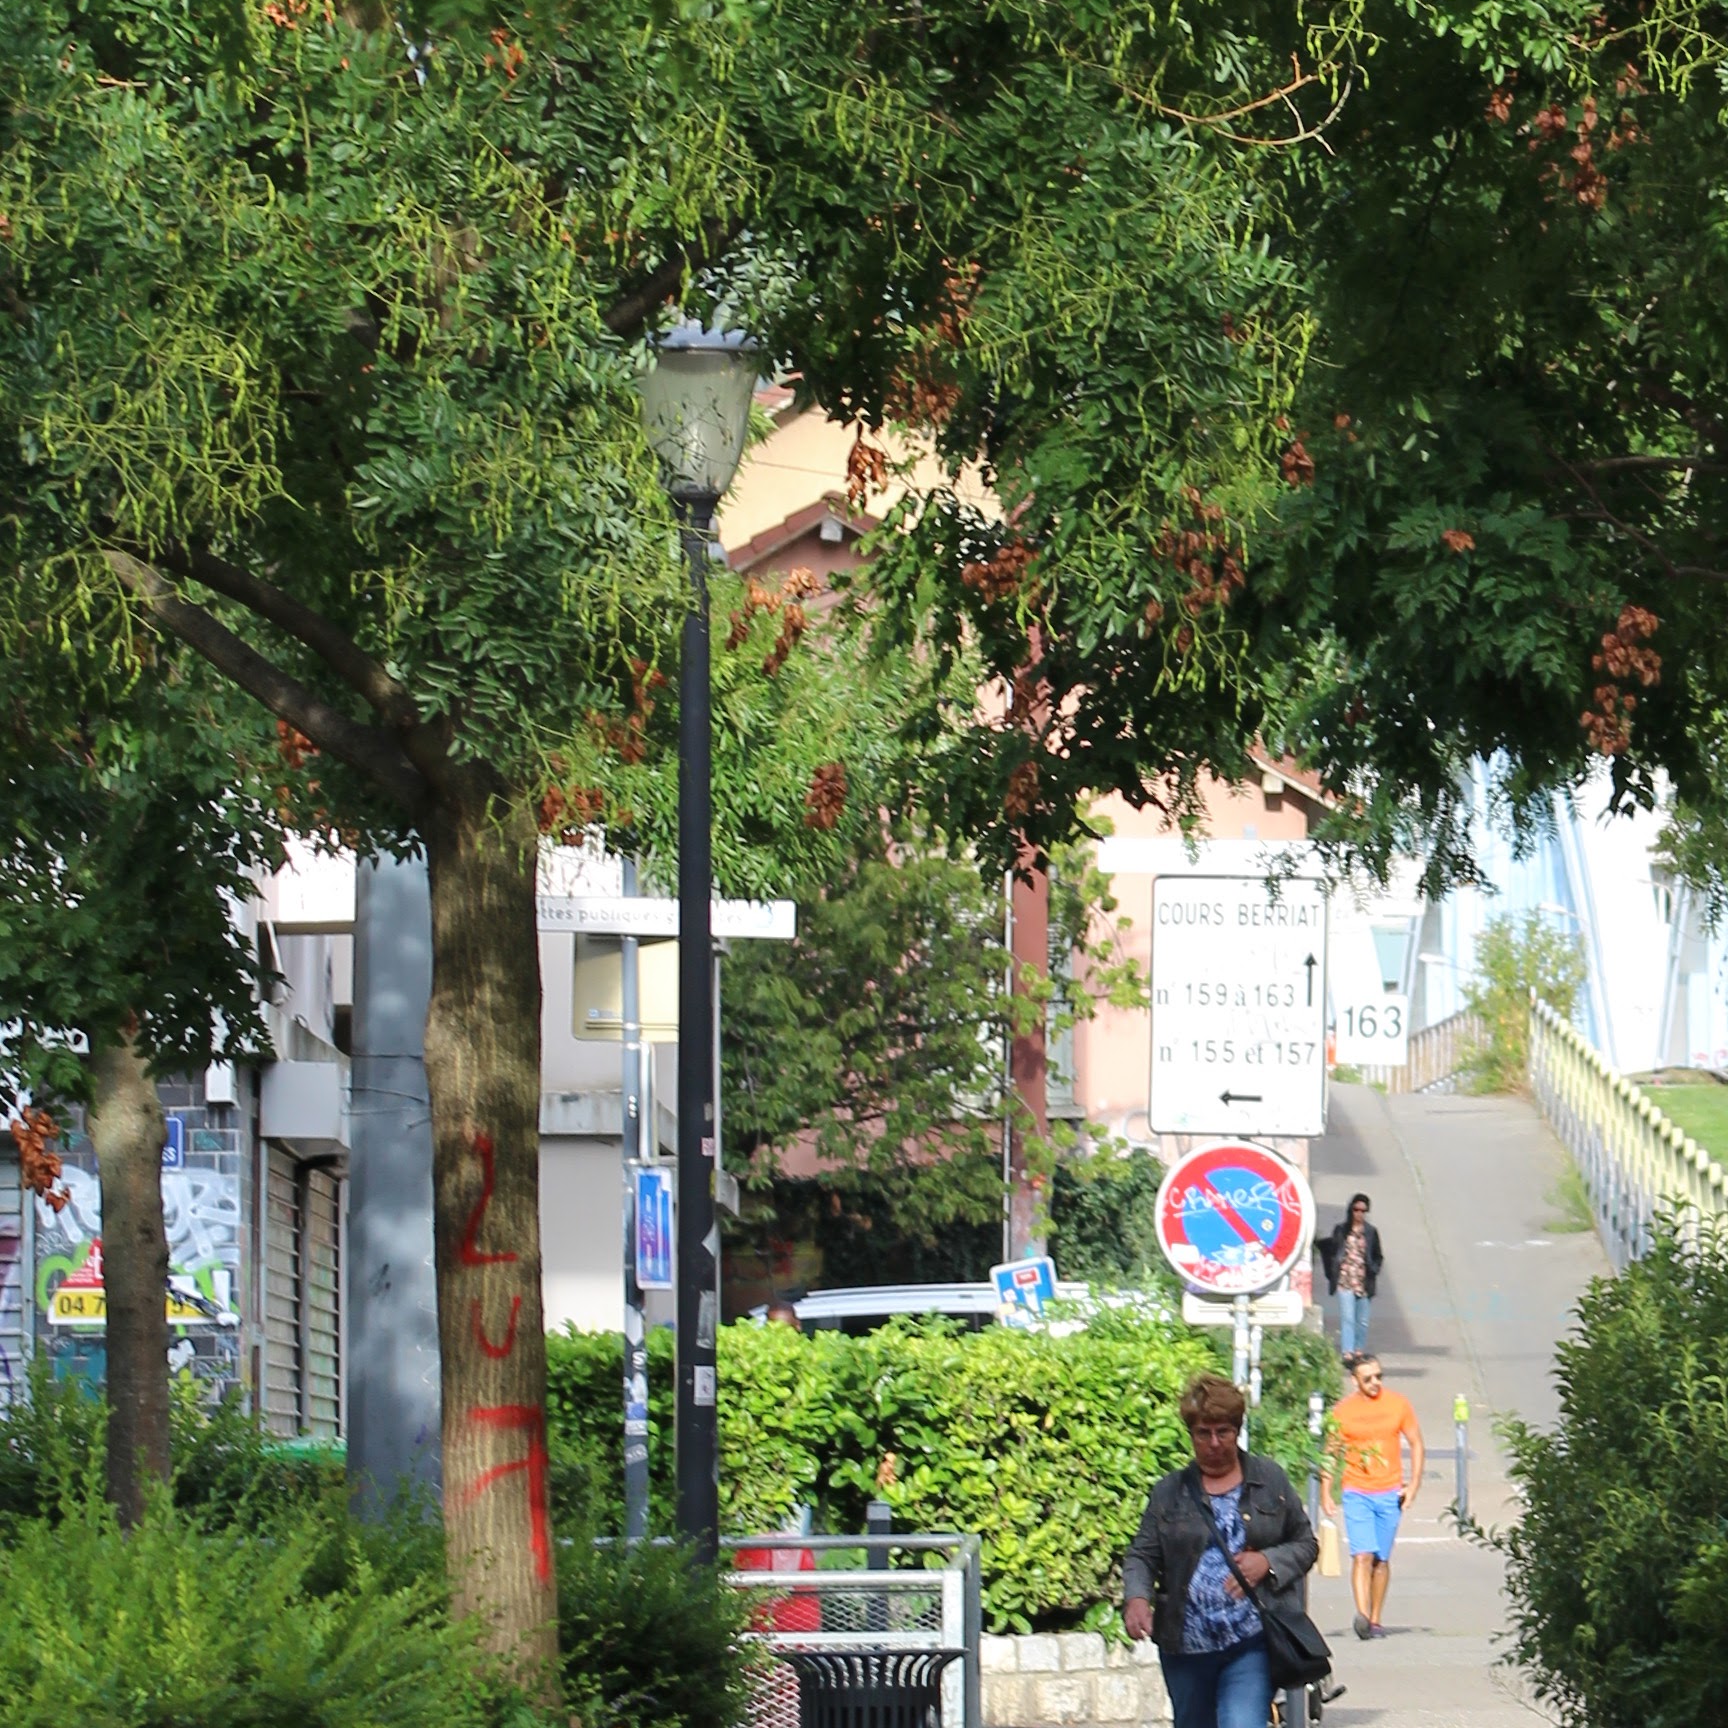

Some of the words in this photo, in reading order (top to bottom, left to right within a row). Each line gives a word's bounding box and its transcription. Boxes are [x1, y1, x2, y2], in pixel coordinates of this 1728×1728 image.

[1158, 902, 1225, 926] COURS
[1238, 903, 1320, 927] BERRIAT
[1186, 983, 1228, 1007] 159
[1235, 983, 1247, 1007] à
[1254, 983, 1295, 1007] 163
[1343, 1004, 1402, 1040] 163
[1192, 1039, 1235, 1064] 155
[1245, 1041, 1264, 1064] et
[1276, 1042, 1317, 1066] 157
[59, 1295, 86, 1315] 04
